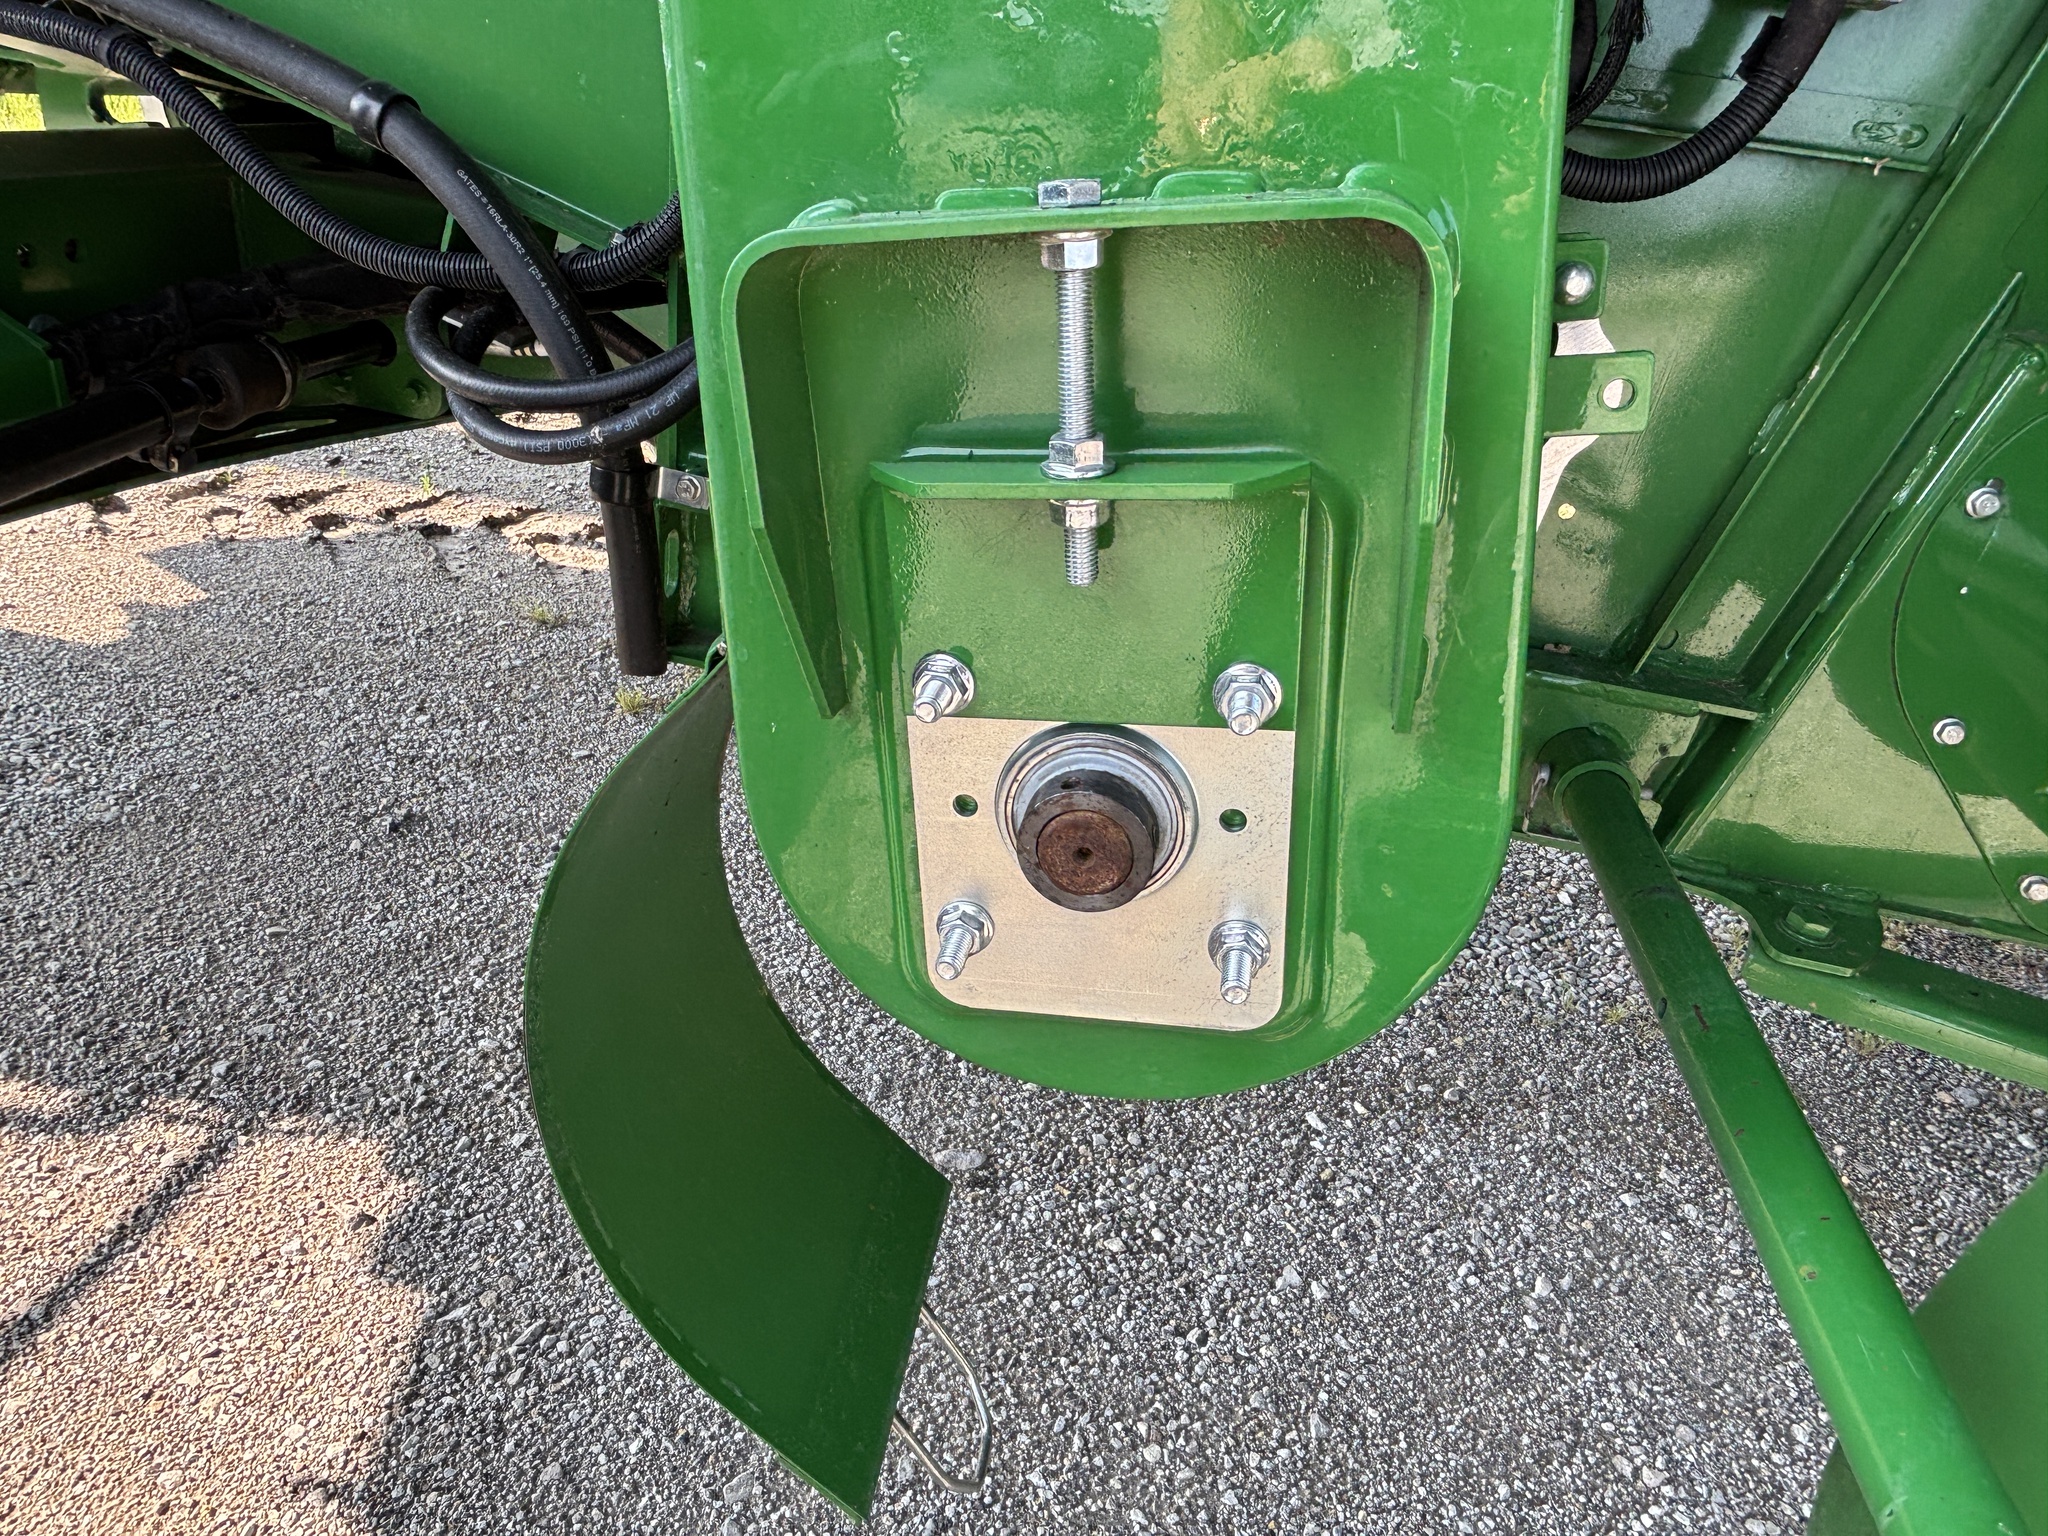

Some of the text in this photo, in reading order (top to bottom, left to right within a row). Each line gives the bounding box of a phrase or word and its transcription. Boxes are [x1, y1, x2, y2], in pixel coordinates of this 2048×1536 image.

[456, 169, 483, 198] GATES
[568, 327, 581, 345] PSI
[645, 405, 660, 419] 21
